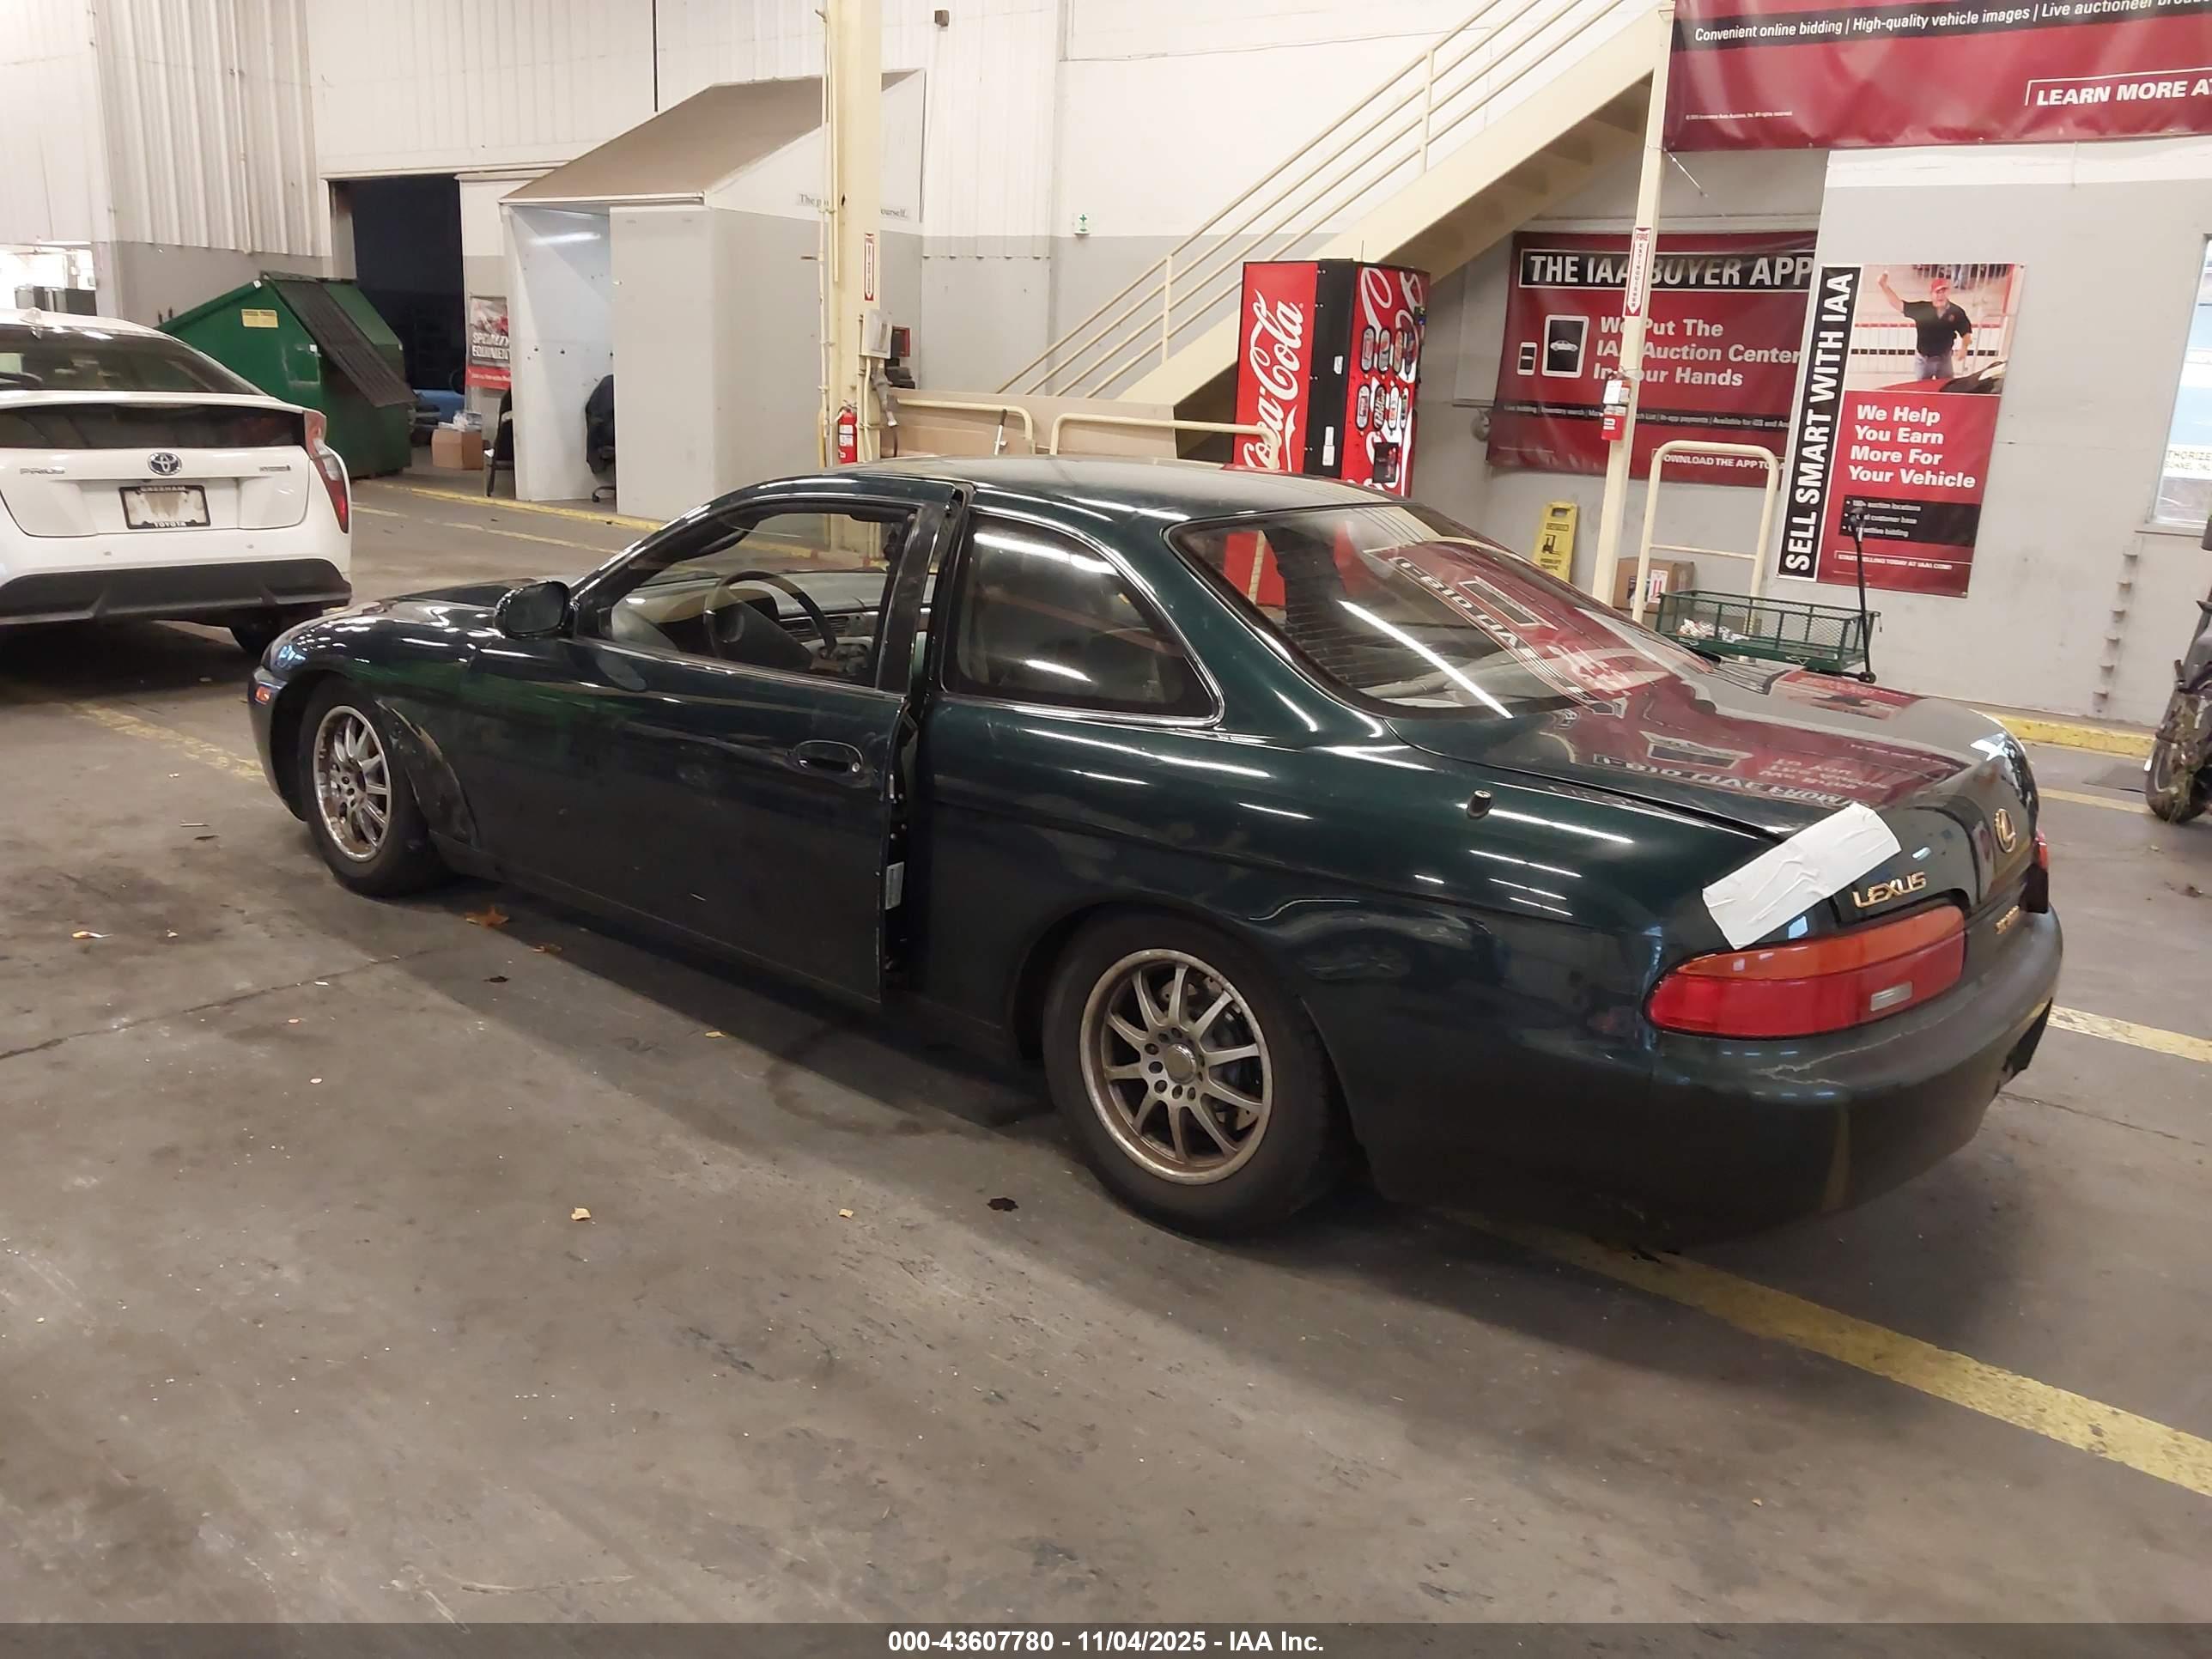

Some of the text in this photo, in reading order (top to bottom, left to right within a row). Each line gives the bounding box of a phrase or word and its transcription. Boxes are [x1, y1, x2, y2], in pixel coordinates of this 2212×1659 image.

[1695, 24, 1757, 41] Convenient
[1759, 22, 1796, 37] online
[1799, 20, 1843, 35] bidding
[1853, 14, 1928, 33] High-quality
[1932, 11, 1978, 27] vehicle
[1982, 8, 2030, 24] images
[2042, 3, 2070, 18] Live
[2037, 78, 2212, 106] LEARN MORE A
[1530, 255, 1580, 283] THE
[1651, 258, 1742, 286] BUYER
[1748, 256, 1814, 286] APP
[1683, 319, 1724, 337] The
[1596, 339, 1802, 364] IA Auction Center
[1675, 367, 1744, 386] Hands
[1784, 272, 1854, 571] SELL SMART WITH IAA
[1856, 404, 1941, 427] We Help
[1855, 424, 1944, 445] You Earn
[1662, 453, 1713, 465] OWNLOAD
[1716, 459, 1735, 467] THE
[1735, 459, 1758, 469] APP
[1850, 446, 1943, 465] More For
[1848, 465, 1977, 489] Your Vehicle
[1851, 871, 1928, 908] LEXUS
